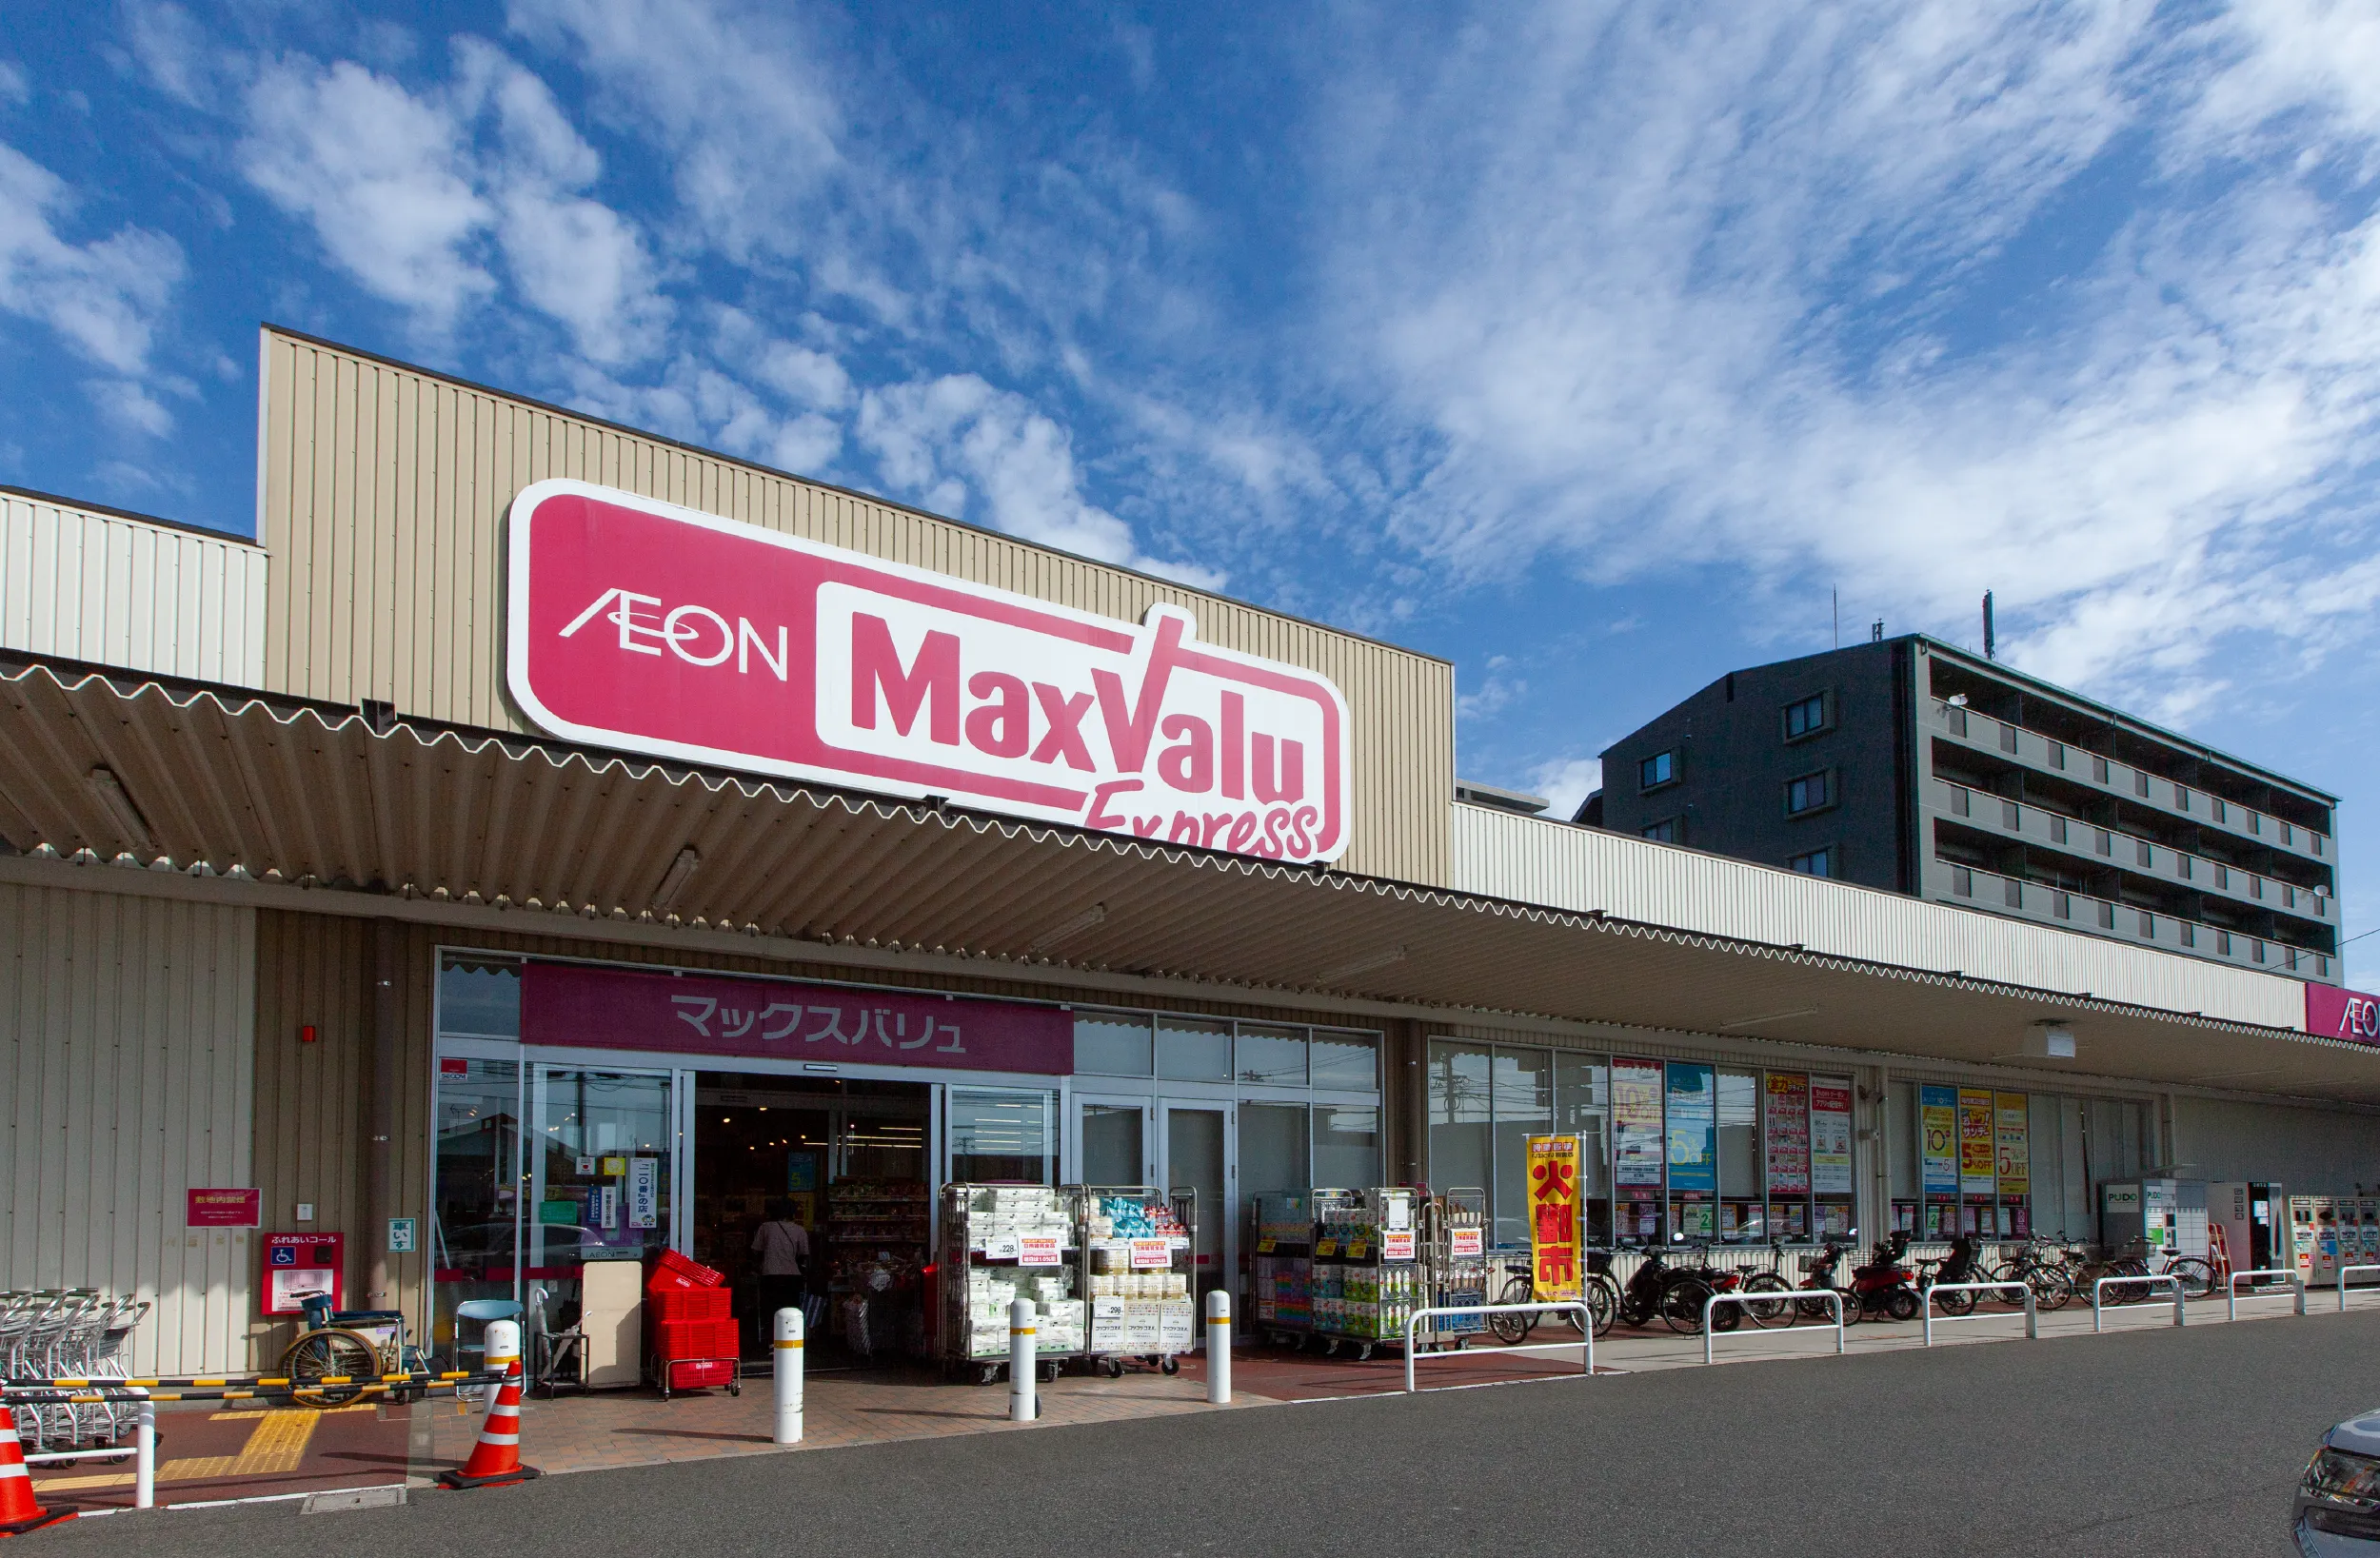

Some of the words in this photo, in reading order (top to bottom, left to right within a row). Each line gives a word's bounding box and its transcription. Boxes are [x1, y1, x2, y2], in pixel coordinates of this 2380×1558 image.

[850, 614, 1304, 806] MaxValu
[670, 995, 966, 1054] マックスバリュ
[2339, 996, 2380, 1037] AEO
[2108, 1193, 2138, 1202] PUDO
[271, 1235, 337, 1244] ふれあいコール
[392, 1222, 408, 1249] 車いす
[1002, 1245, 1015, 1253] 228
